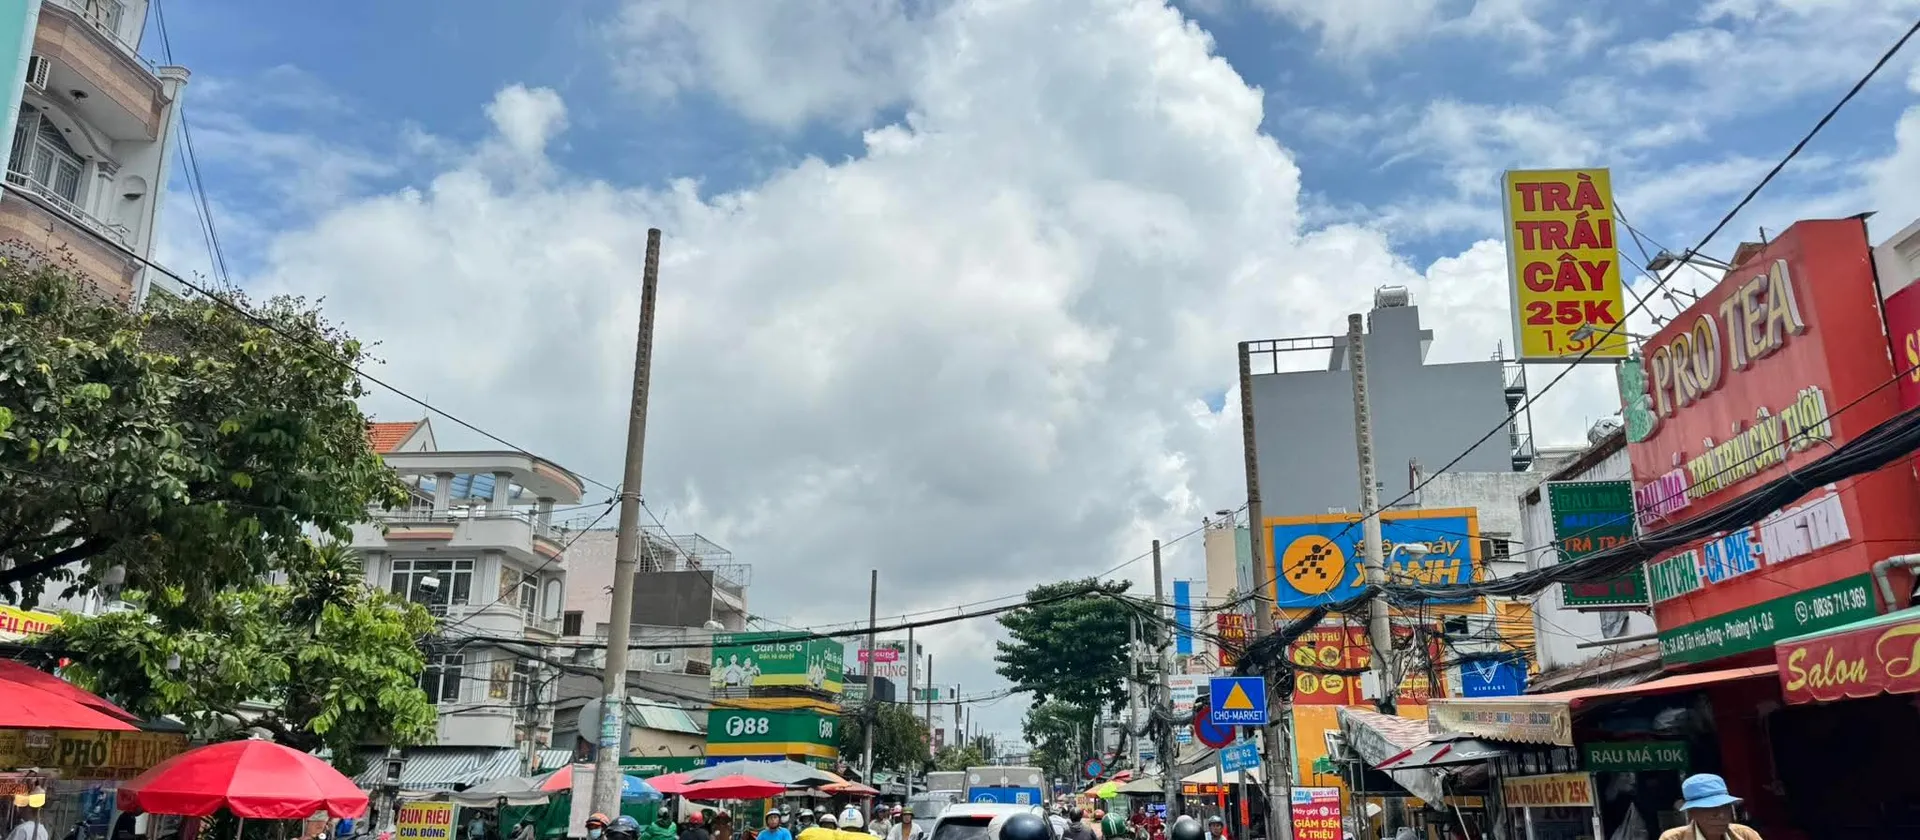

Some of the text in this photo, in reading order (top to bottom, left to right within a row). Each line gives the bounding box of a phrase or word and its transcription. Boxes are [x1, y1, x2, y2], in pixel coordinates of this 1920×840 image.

[1515, 172, 1604, 211] TRÀ
[1515, 210, 1613, 250] TRÁI
[1523, 252, 1611, 292] CÂY
[1526, 300, 1616, 325] 25K
[1651, 259, 1804, 418] PRO TEA
[1650, 550, 1702, 602] MATCHA
[1813, 586, 1867, 619] 0835 714 369
[1786, 647, 1868, 691] Salon
[726, 716, 769, 736] F88
[819, 718, 833, 738] F88
[1591, 750, 1623, 763] RAU
[1627, 746, 1651, 763] MÁ
[1656, 749, 1684, 763] 10K
[1568, 780, 1589, 803] 25K
[400, 805, 422, 824] BÚN
[1294, 817, 1340, 828] GIẢM ĐẾN
[400, 827, 417, 837] CUA
[1299, 829, 1306, 838] 4
